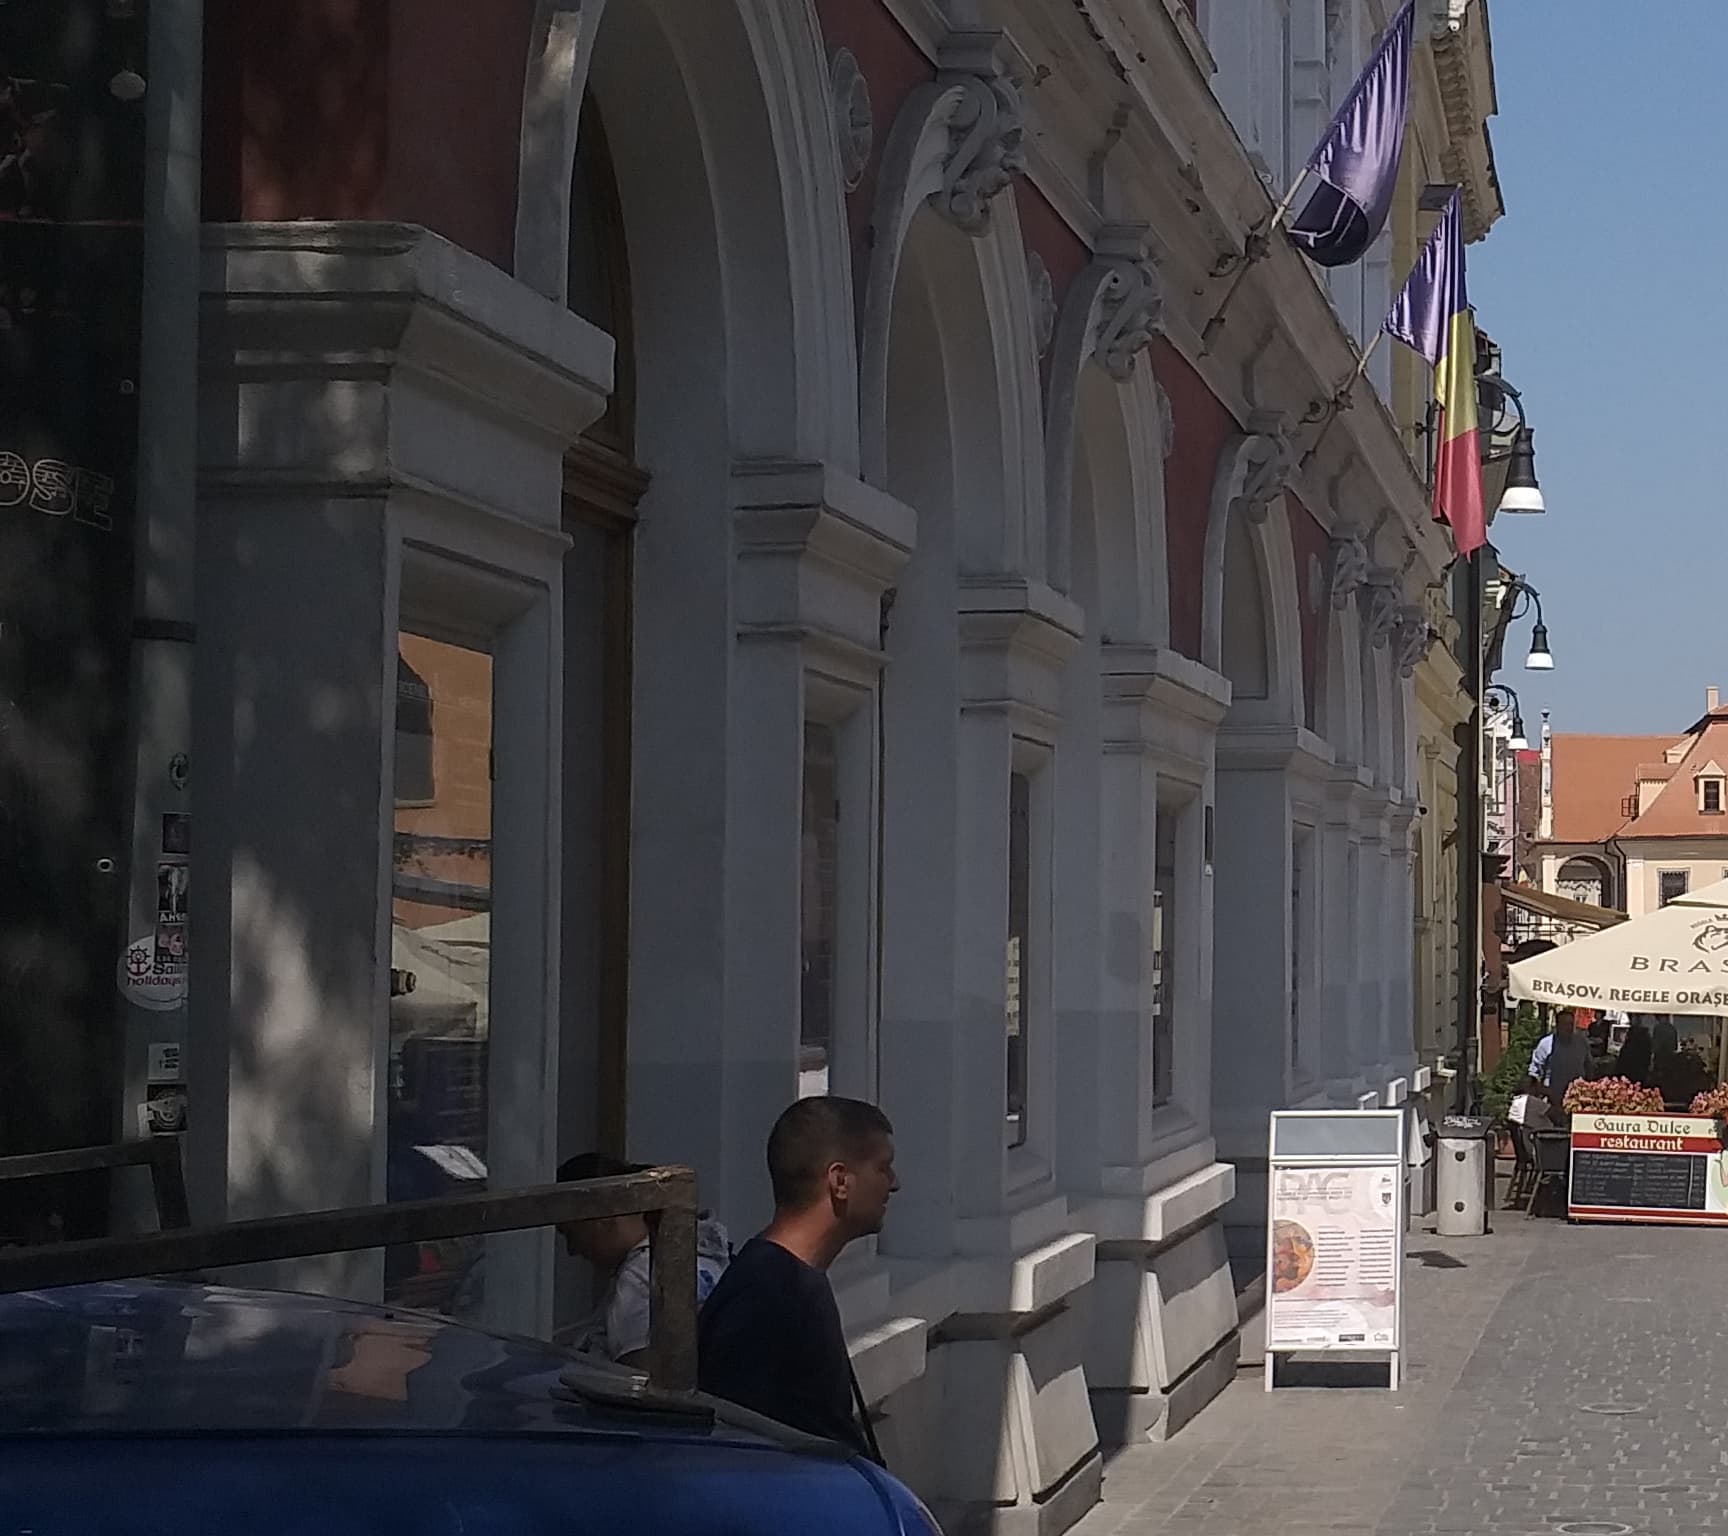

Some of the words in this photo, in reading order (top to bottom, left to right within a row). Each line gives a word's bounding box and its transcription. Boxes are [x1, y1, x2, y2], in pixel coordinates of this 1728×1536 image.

[1532, 980, 1602, 1000] BRAȘOV.
[1609, 988, 1669, 1003] REGELE
[1594, 1118, 1641, 1133] Gaura
[1647, 1120, 1691, 1134] Dulce
[1600, 1135, 1684, 1151] restaurant
